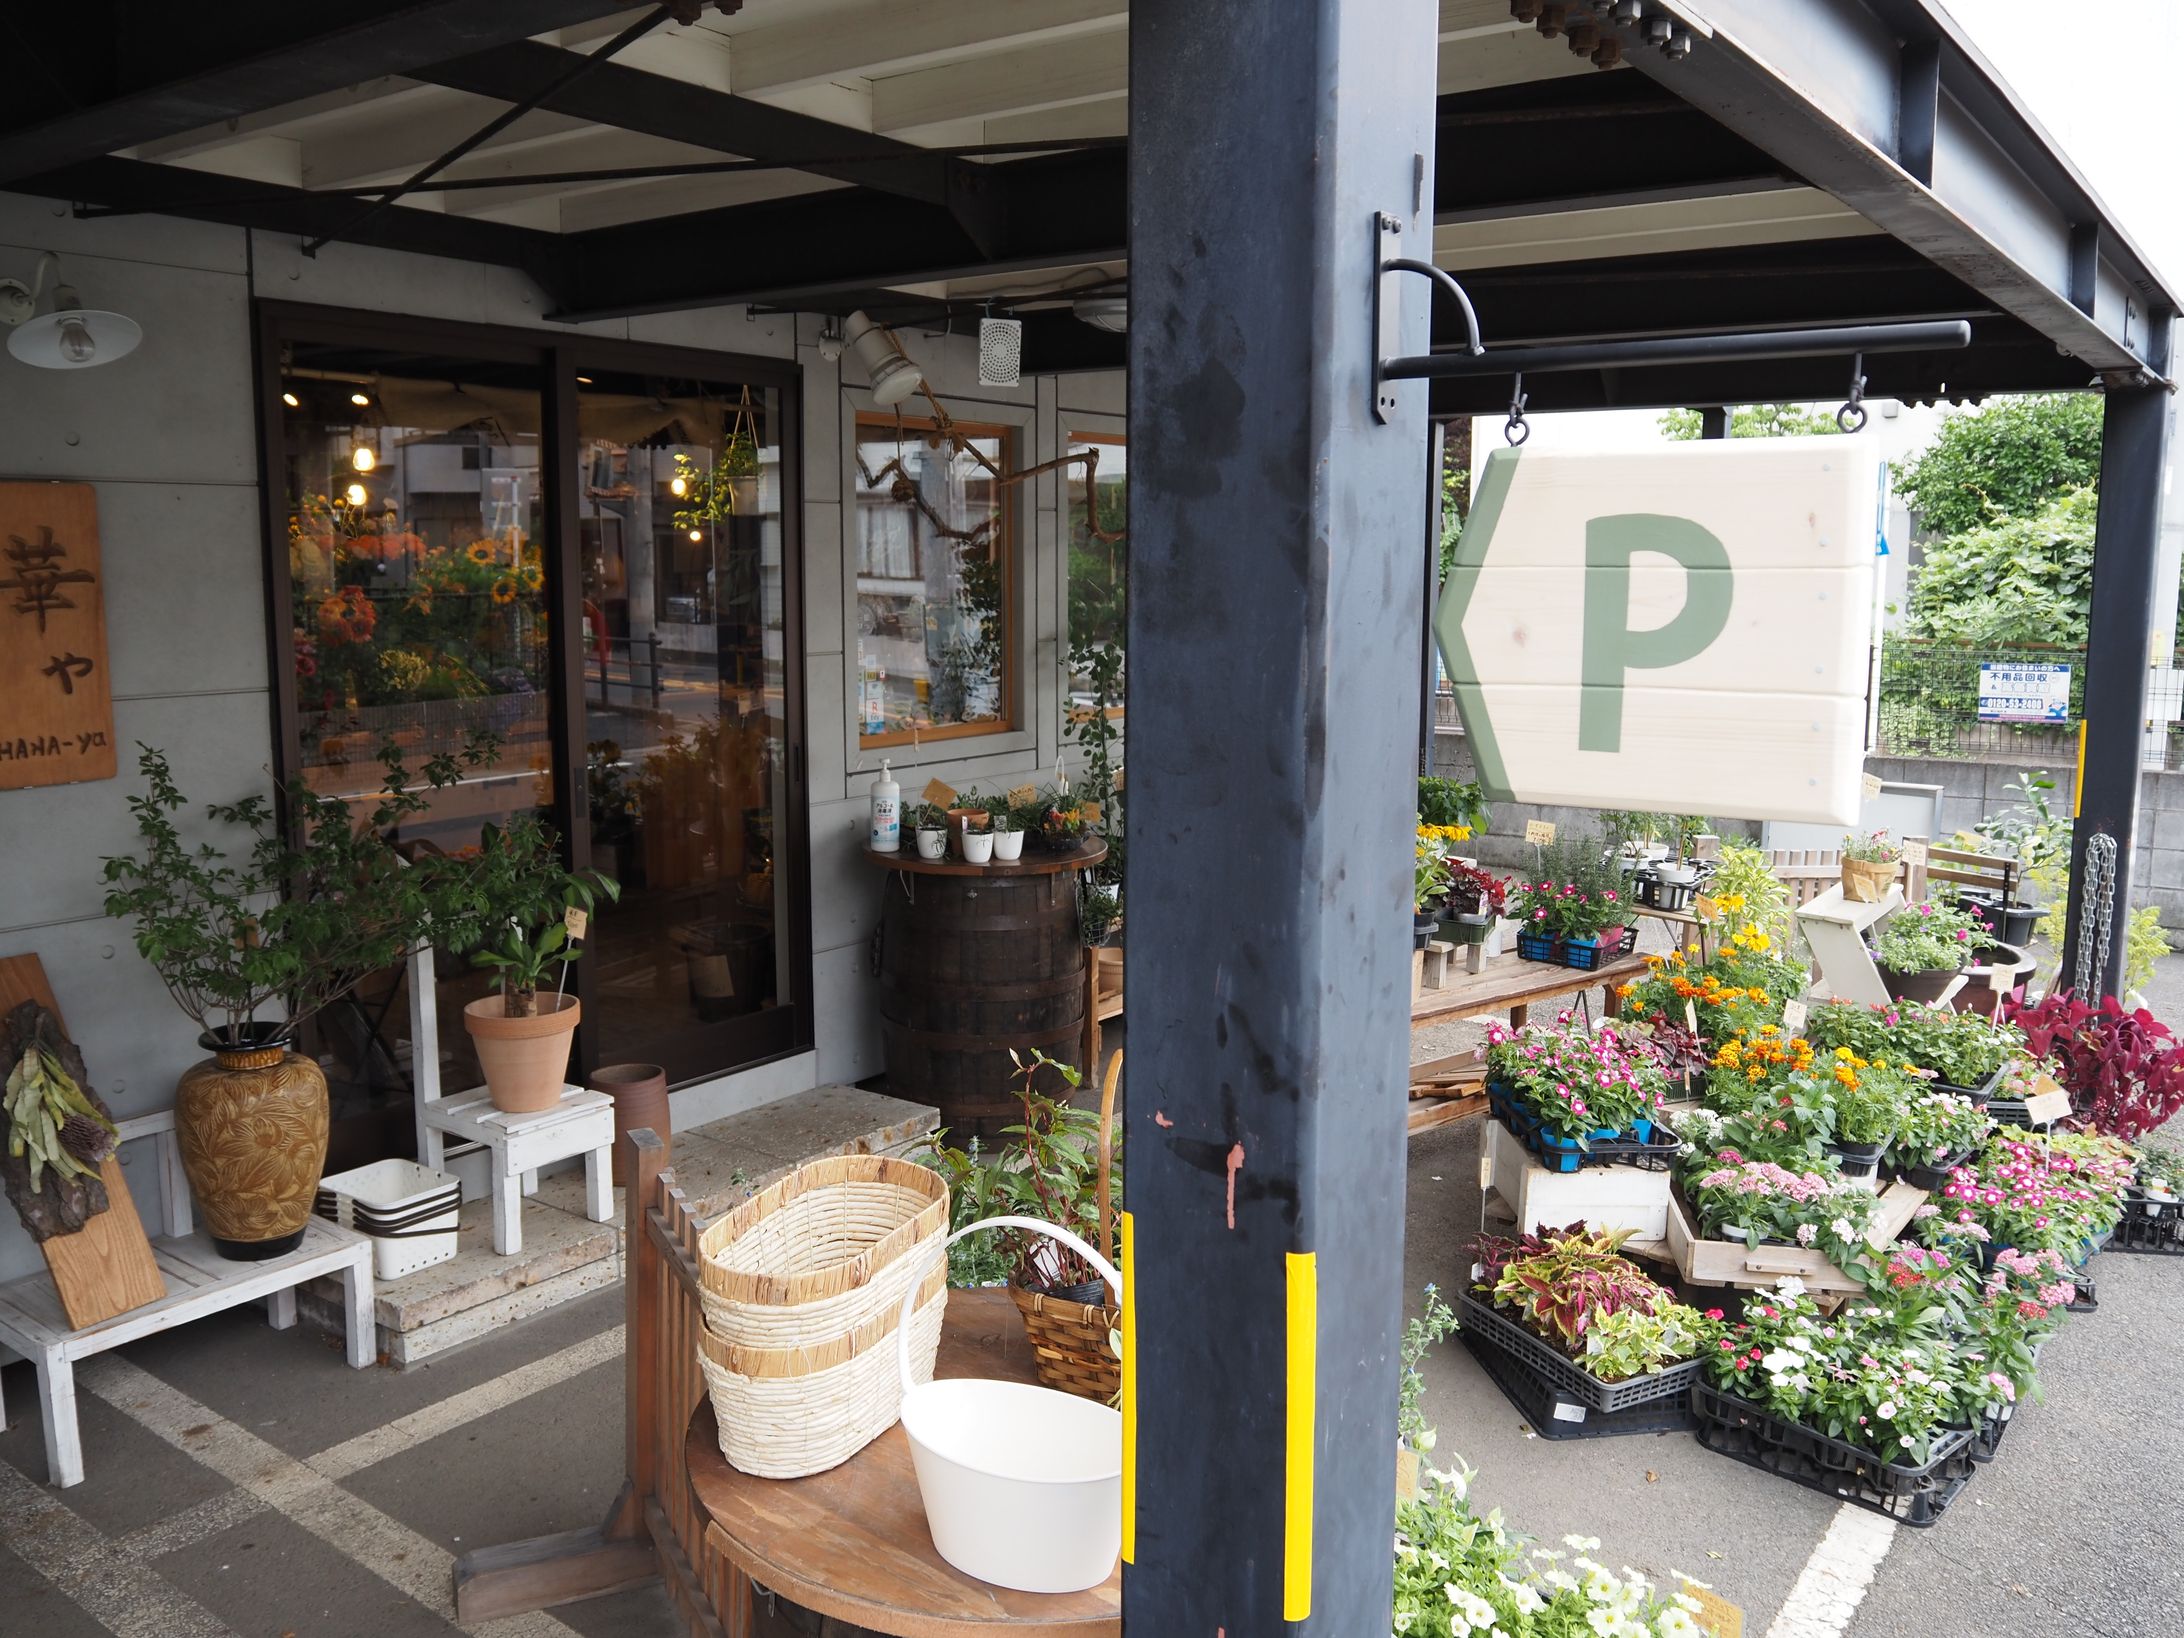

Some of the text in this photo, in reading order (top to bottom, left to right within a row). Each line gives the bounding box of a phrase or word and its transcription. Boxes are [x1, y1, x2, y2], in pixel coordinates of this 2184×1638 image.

[1579, 513, 1734, 753] P
[1990, 672, 2047, 682] 不用品回収
